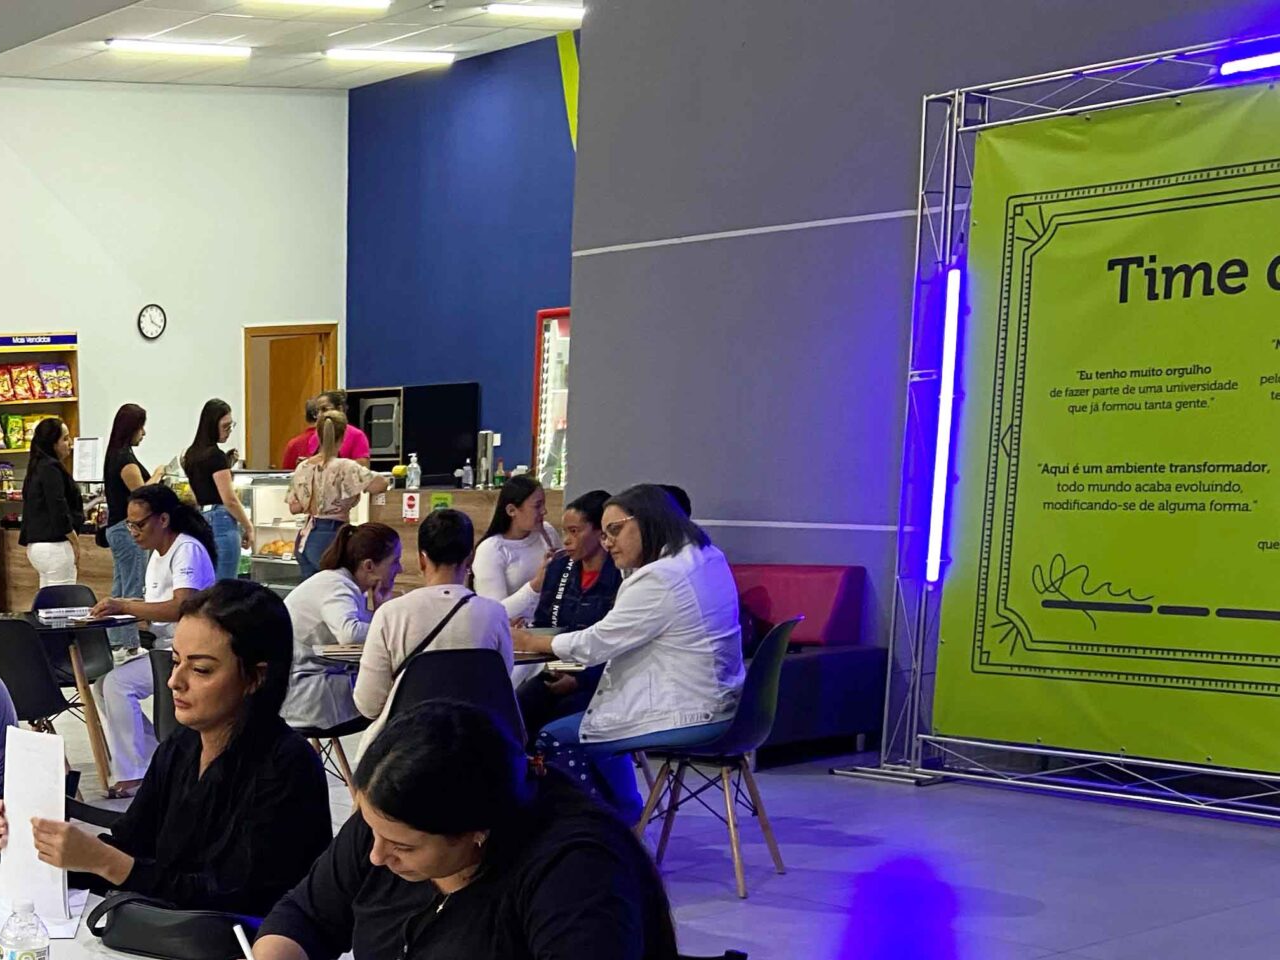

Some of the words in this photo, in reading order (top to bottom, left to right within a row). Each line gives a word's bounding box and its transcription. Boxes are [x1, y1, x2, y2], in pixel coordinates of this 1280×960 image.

[1107, 255, 1249, 304] Time
[1096, 369, 1127, 380] tenho
[1130, 367, 1163, 378] muito
[1165, 364, 1212, 378] orgulho
[1050, 388, 1063, 398] de
[1064, 387, 1090, 398] fazer
[1092, 386, 1120, 398] parte
[1122, 384, 1136, 394] de
[1138, 384, 1163, 394] uma
[1166, 380, 1238, 393] universidade
[1068, 404, 1088, 414] que
[1089, 402, 1100, 414] já
[1102, 401, 1142, 412] formou
[1144, 400, 1172, 410] tanta
[1072, 462, 1080, 474] é
[1083, 464, 1102, 474] um
[1106, 462, 1166, 474] ambiente
[1169, 461, 1271, 474] transformador,
[1056, 481, 1084, 493] todo
[1088, 481, 1132, 492] mundo
[1135, 481, 1171, 492] acaba
[1174, 480, 1243, 494] evoluindo,
[1043, 499, 1136, 511] modificando-se
[1139, 499, 1155, 511] de
[1158, 500, 1206, 514] alguma
